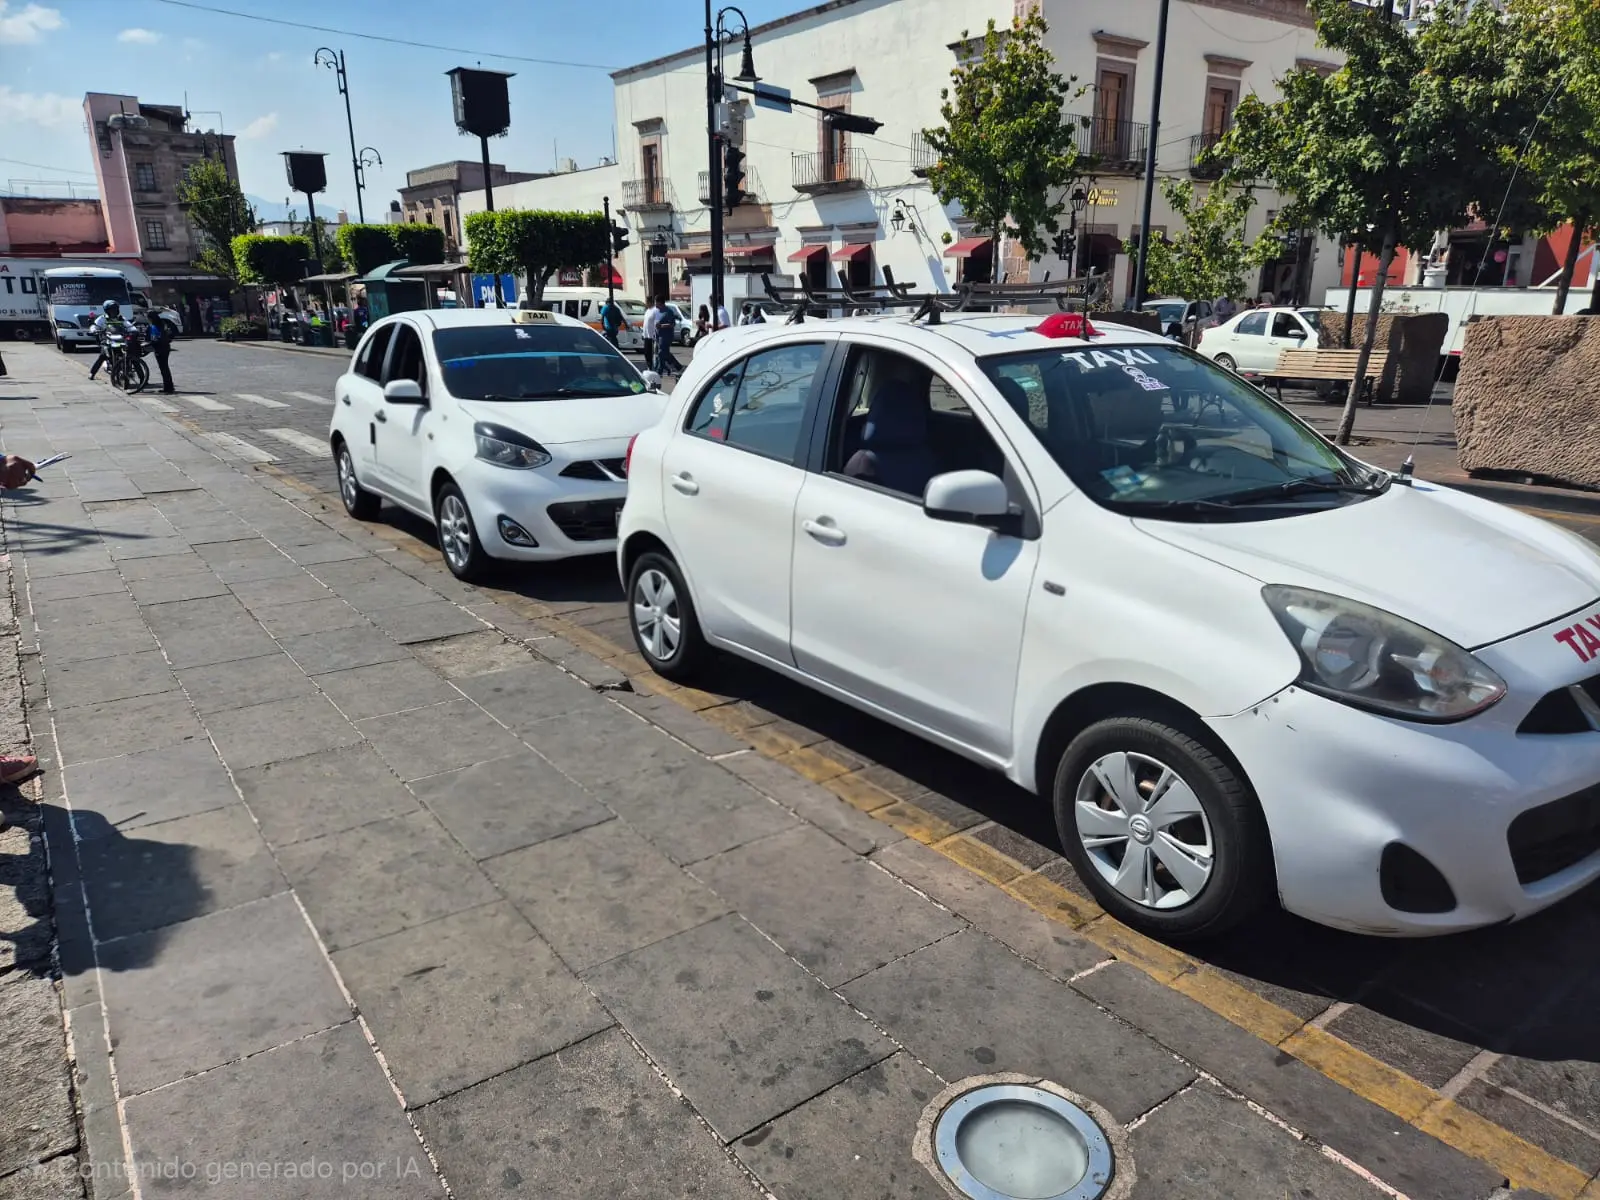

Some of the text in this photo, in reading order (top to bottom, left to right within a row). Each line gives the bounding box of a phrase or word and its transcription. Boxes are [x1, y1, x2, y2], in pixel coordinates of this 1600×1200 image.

[527, 312, 548, 320] TAXI
[1064, 320, 1085, 330] TAX
[1061, 348, 1159, 369] TAXI
